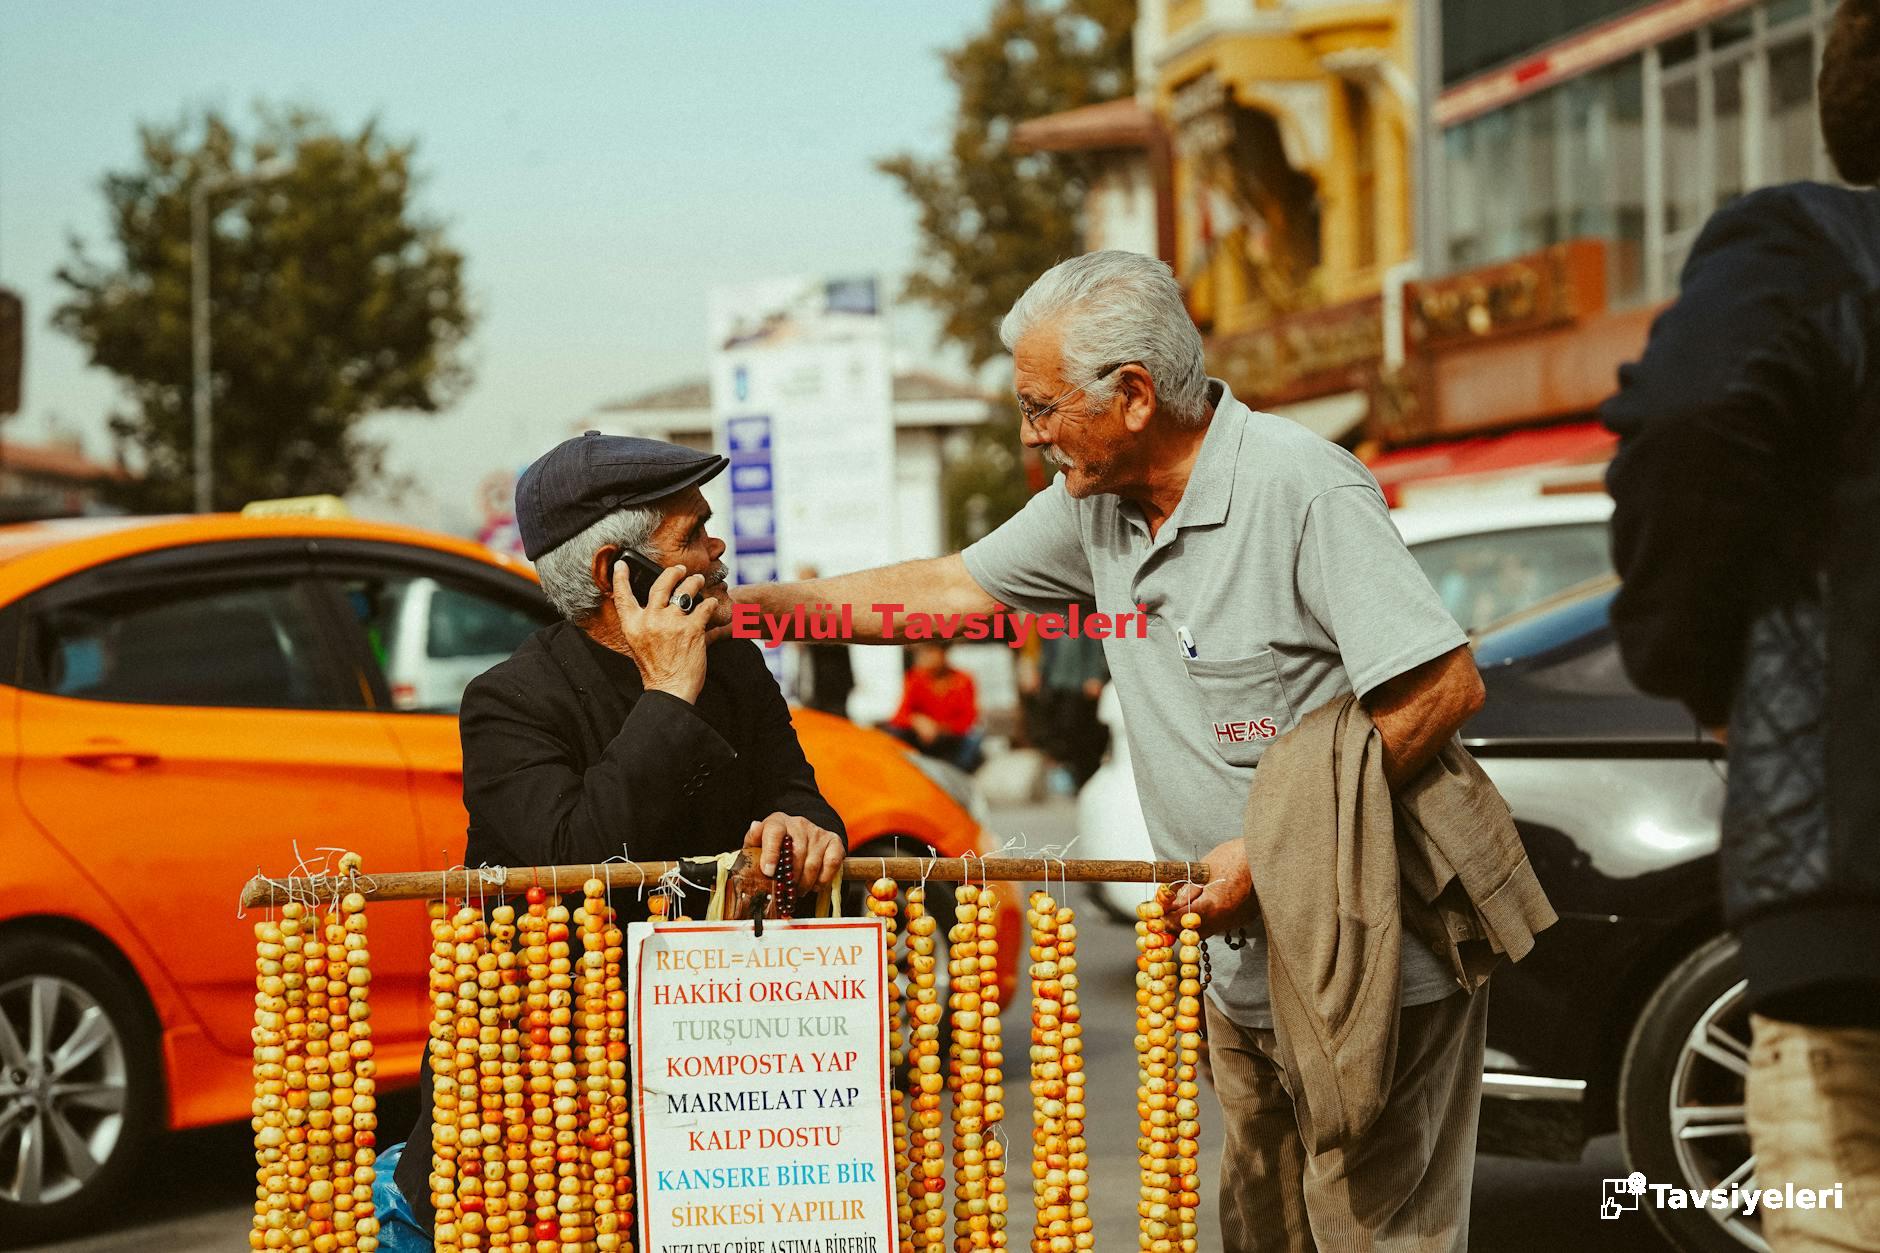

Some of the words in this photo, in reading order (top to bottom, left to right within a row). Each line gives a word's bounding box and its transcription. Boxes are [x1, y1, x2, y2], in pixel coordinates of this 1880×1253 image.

[653, 978, 744, 1006] HAKİKİ
[750, 974, 867, 1003] ORGANİK
[672, 1017, 790, 1046] TURŞUNU
[798, 1015, 849, 1037] KUR
[665, 1053, 806, 1078] KOMPOSTA
[811, 1050, 858, 1073] YAP
[666, 1089, 807, 1114] MARMELAT
[812, 1086, 860, 1109] YAP
[687, 1128, 752, 1152] KALP
[758, 1125, 842, 1150] DOSTU
[656, 1166, 771, 1192] KANSERE
[776, 1159, 830, 1187] BİRE
[836, 1157, 877, 1184] BİR
[671, 1198, 765, 1229] SİRKESİ
[771, 1199, 866, 1224] YAPILIR
